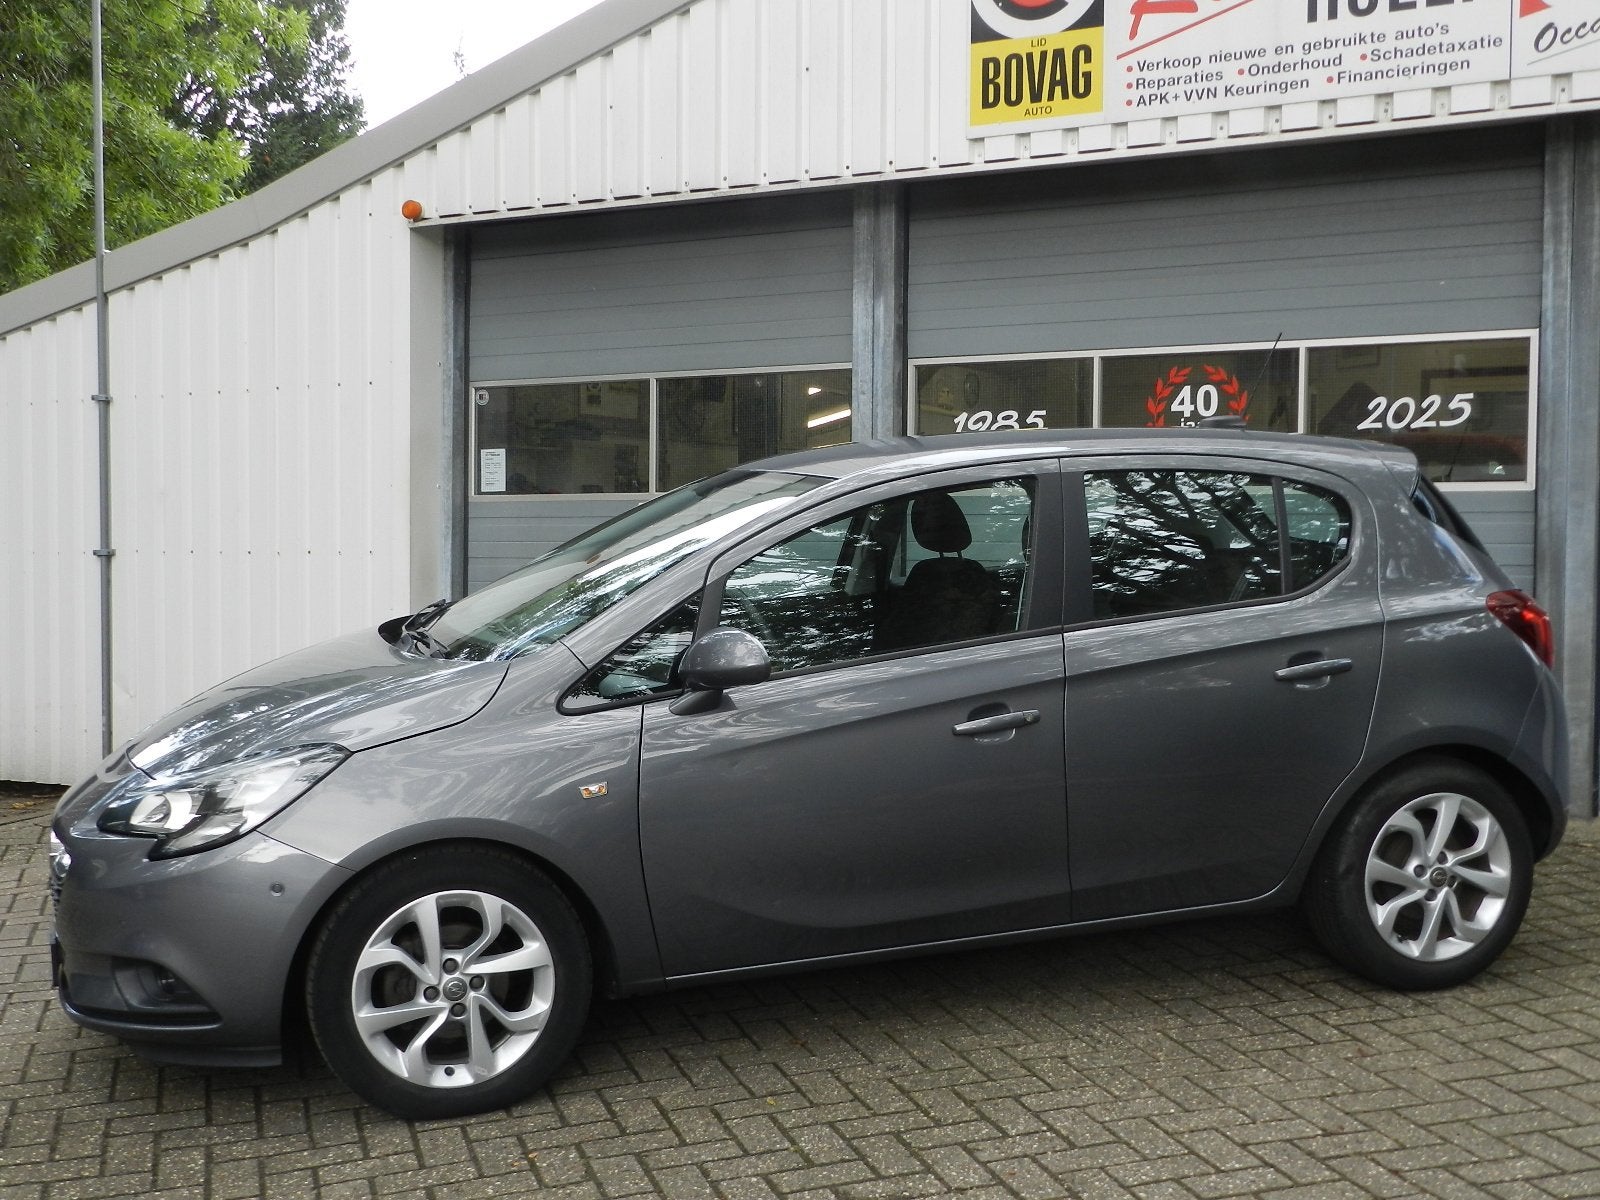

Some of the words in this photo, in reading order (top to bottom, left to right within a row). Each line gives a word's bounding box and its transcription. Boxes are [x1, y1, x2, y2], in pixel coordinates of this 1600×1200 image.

[1031, 38, 1046, 47] LID
[1137, 56, 1201, 73] Verkoop
[1208, 48, 1267, 64] nieuwe
[1274, 43, 1294, 55] en
[1302, 31, 1386, 55] gebruikte
[1394, 23, 1449, 41] auto's
[982, 44, 1092, 109] BOVAG
[1135, 69, 1223, 90] Reparaties
[1248, 54, 1343, 77] Onderhoud
[1370, 35, 1503, 62] Schadetaxatie
[1224, 78, 1310, 98] Keuringen
[1337, 59, 1470, 84] Financieringen
[1024, 106, 1052, 116] AUTO
[1170, 384, 1219, 417] 40
[1356, 392, 1474, 430] 2025
[953, 410, 1047, 433] 1985
